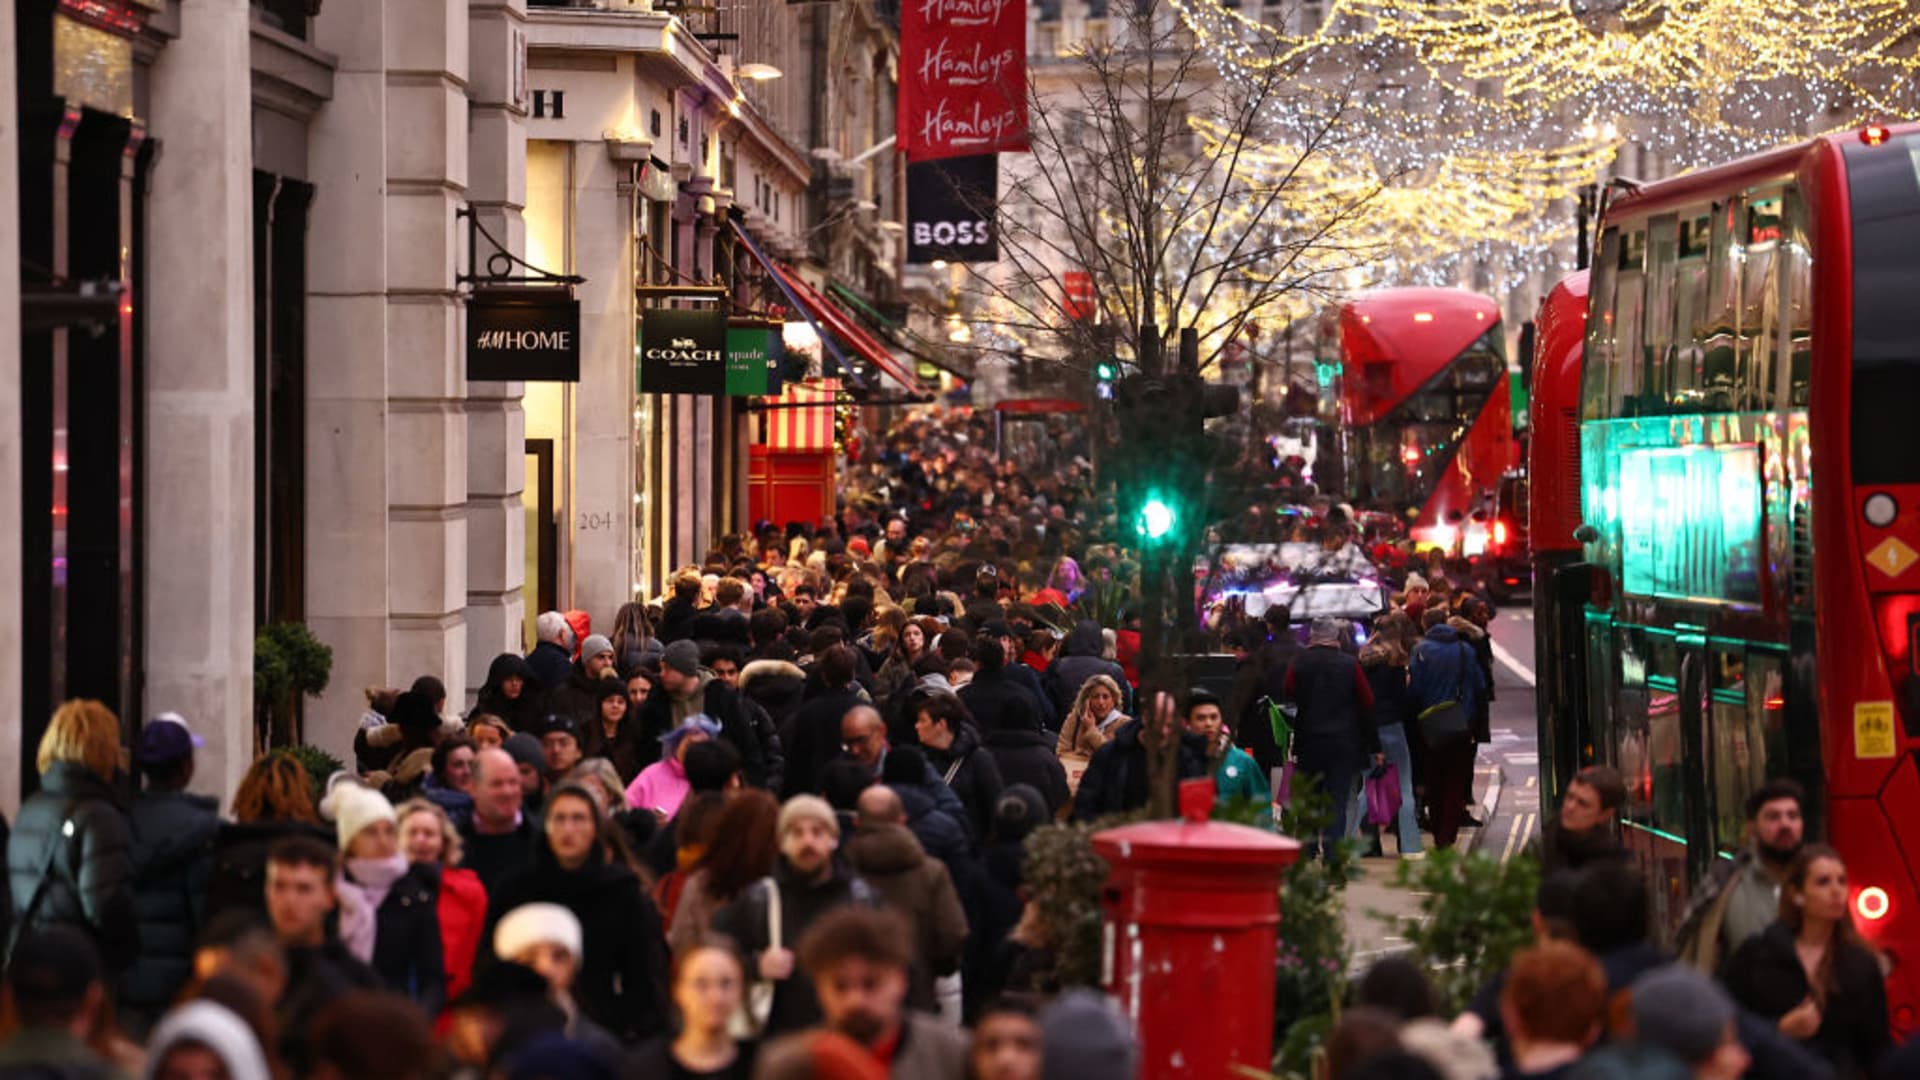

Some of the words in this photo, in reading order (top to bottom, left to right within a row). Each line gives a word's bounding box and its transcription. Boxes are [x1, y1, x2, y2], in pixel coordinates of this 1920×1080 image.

[918, 37, 1014, 85] Hamleys
[525, 89, 567, 119] H
[919, 97, 1015, 147] Hamleys
[913, 221, 990, 246] BOSS
[505, 330, 571, 350] HOME
[646, 349, 721, 361] COACH
[728, 348, 765, 363] spade
[580, 511, 613, 530] 204
